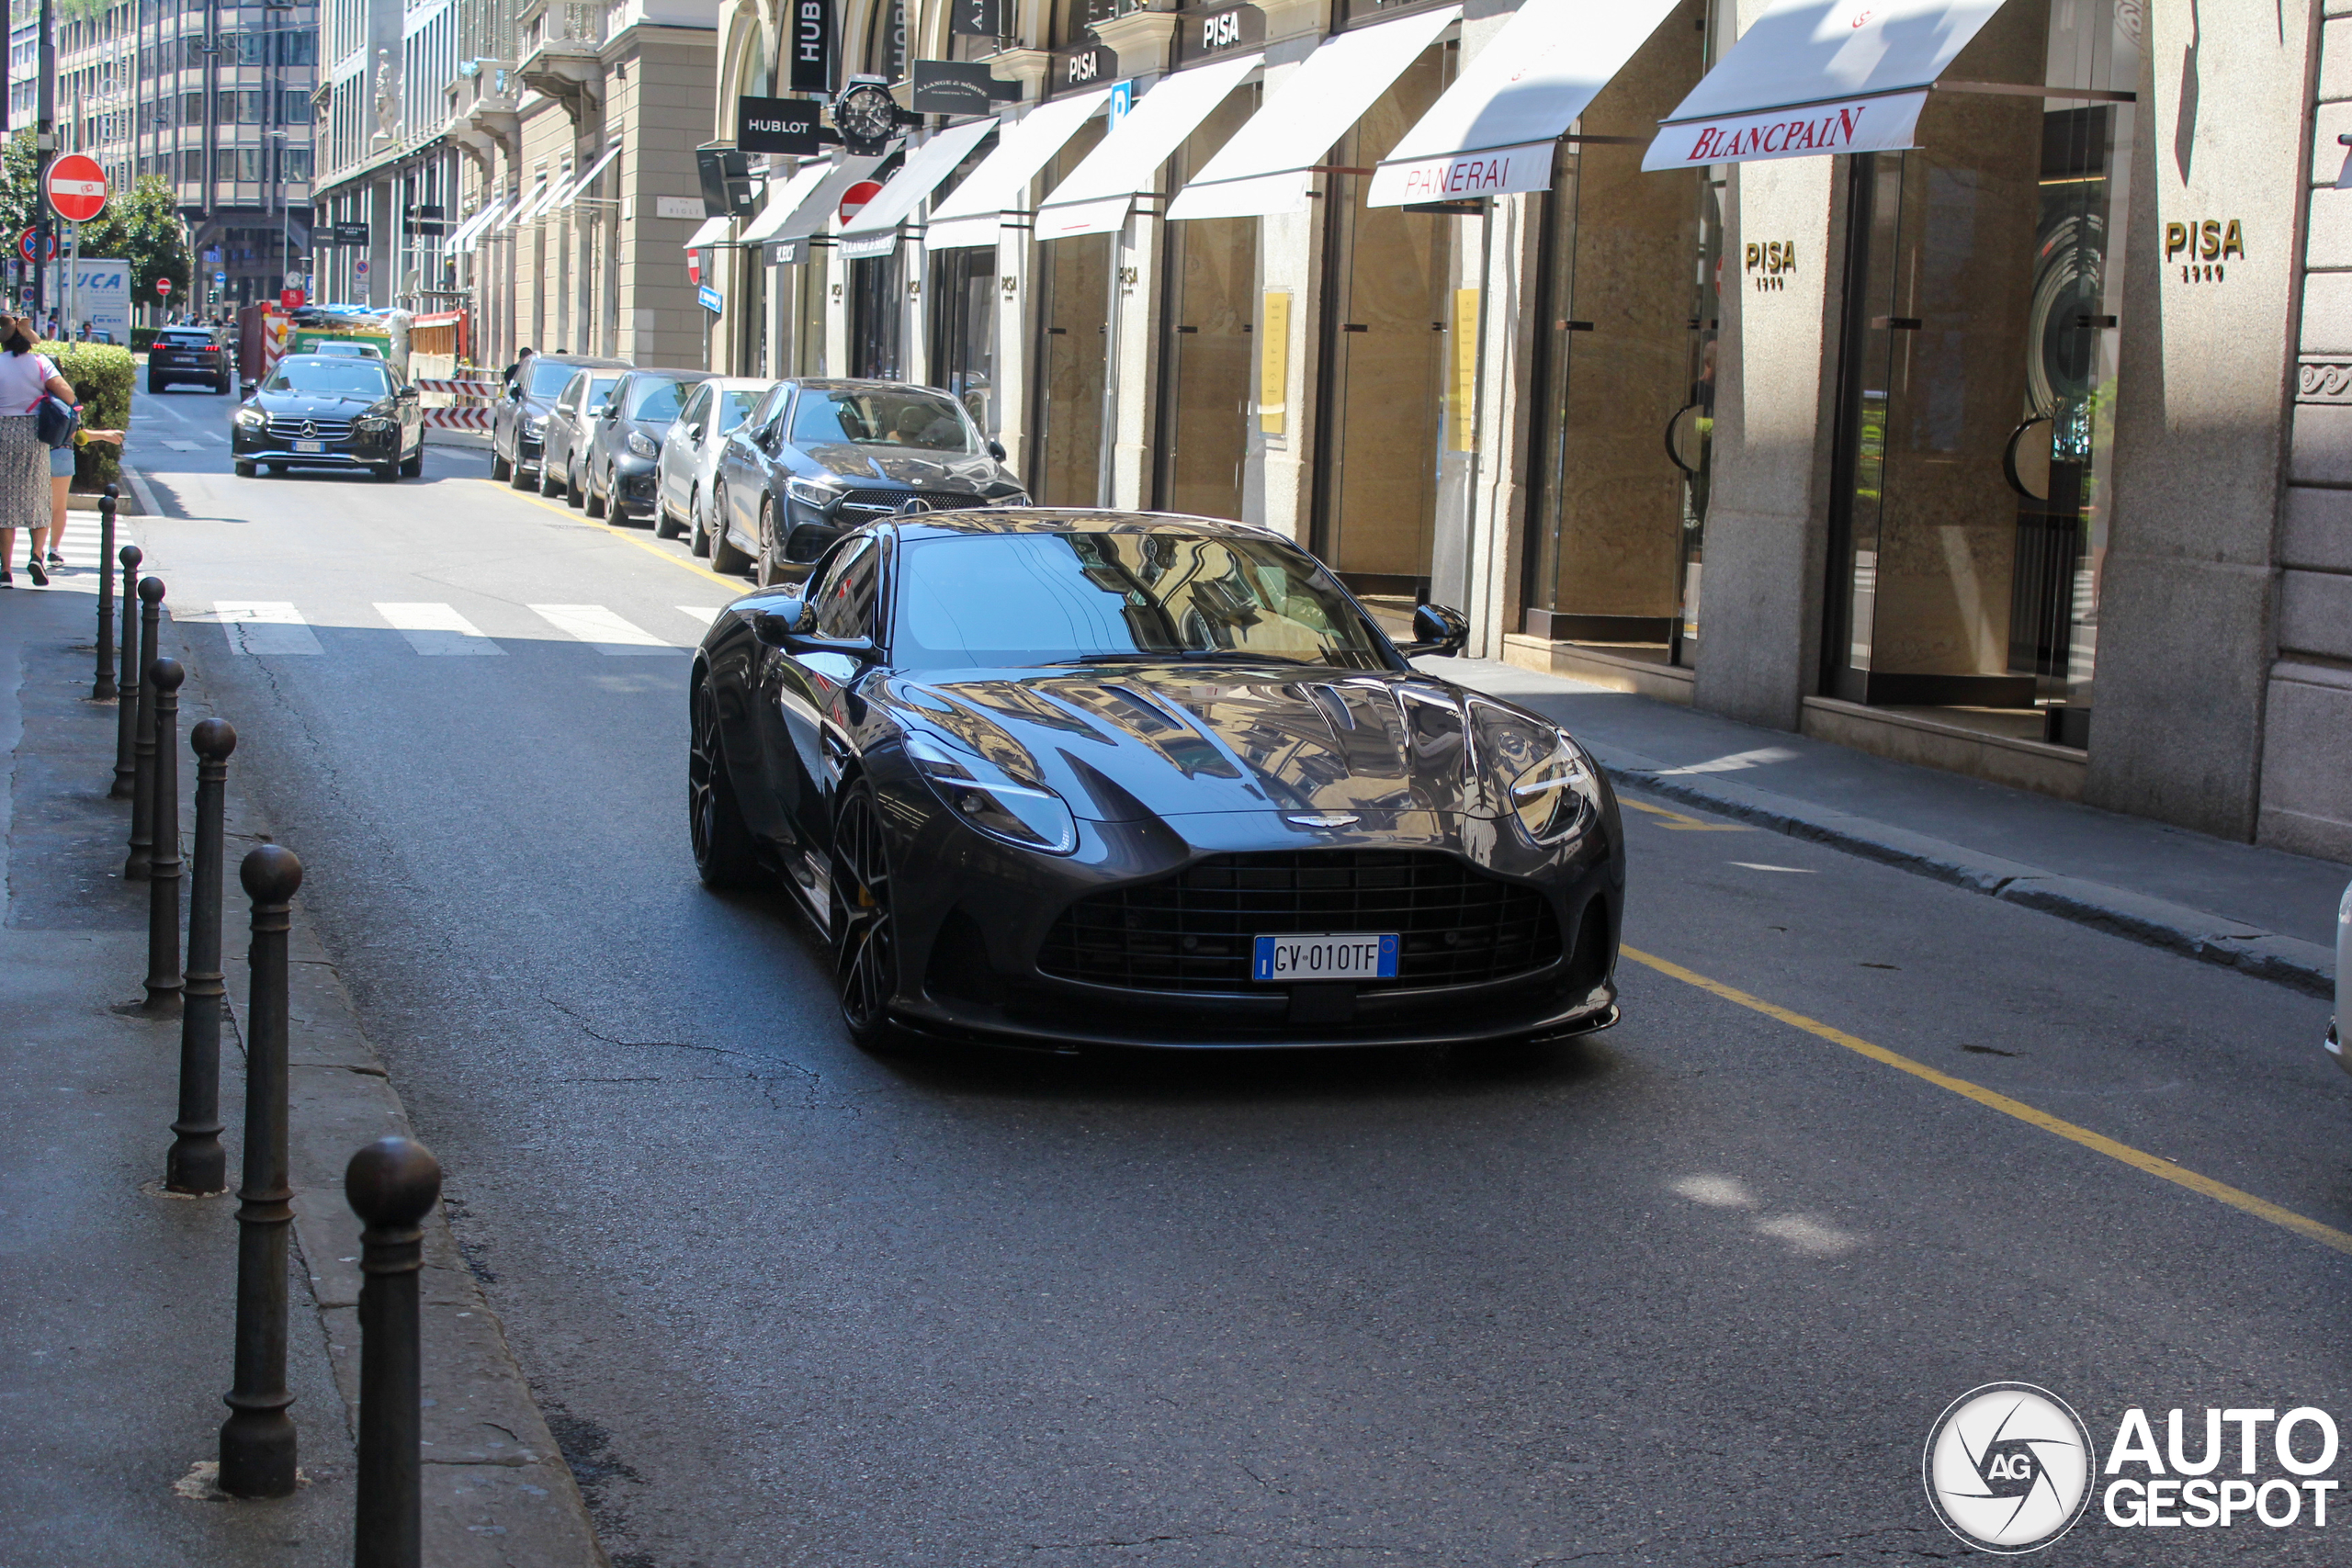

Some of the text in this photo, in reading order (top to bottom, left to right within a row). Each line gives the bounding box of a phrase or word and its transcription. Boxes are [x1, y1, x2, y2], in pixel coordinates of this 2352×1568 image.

[800, 2, 820, 62] HUB
[1204, 11, 1239, 49] PISA
[1069, 51, 1097, 83] PISA
[1113, 90, 1126, 119] P
[748, 118, 809, 134] HUBLOT
[1404, 158, 1510, 197] PANERAI
[669, 208, 699, 216] BIGLI
[2165, 220, 2245, 258] PISA
[1746, 241, 1796, 271] PISA
